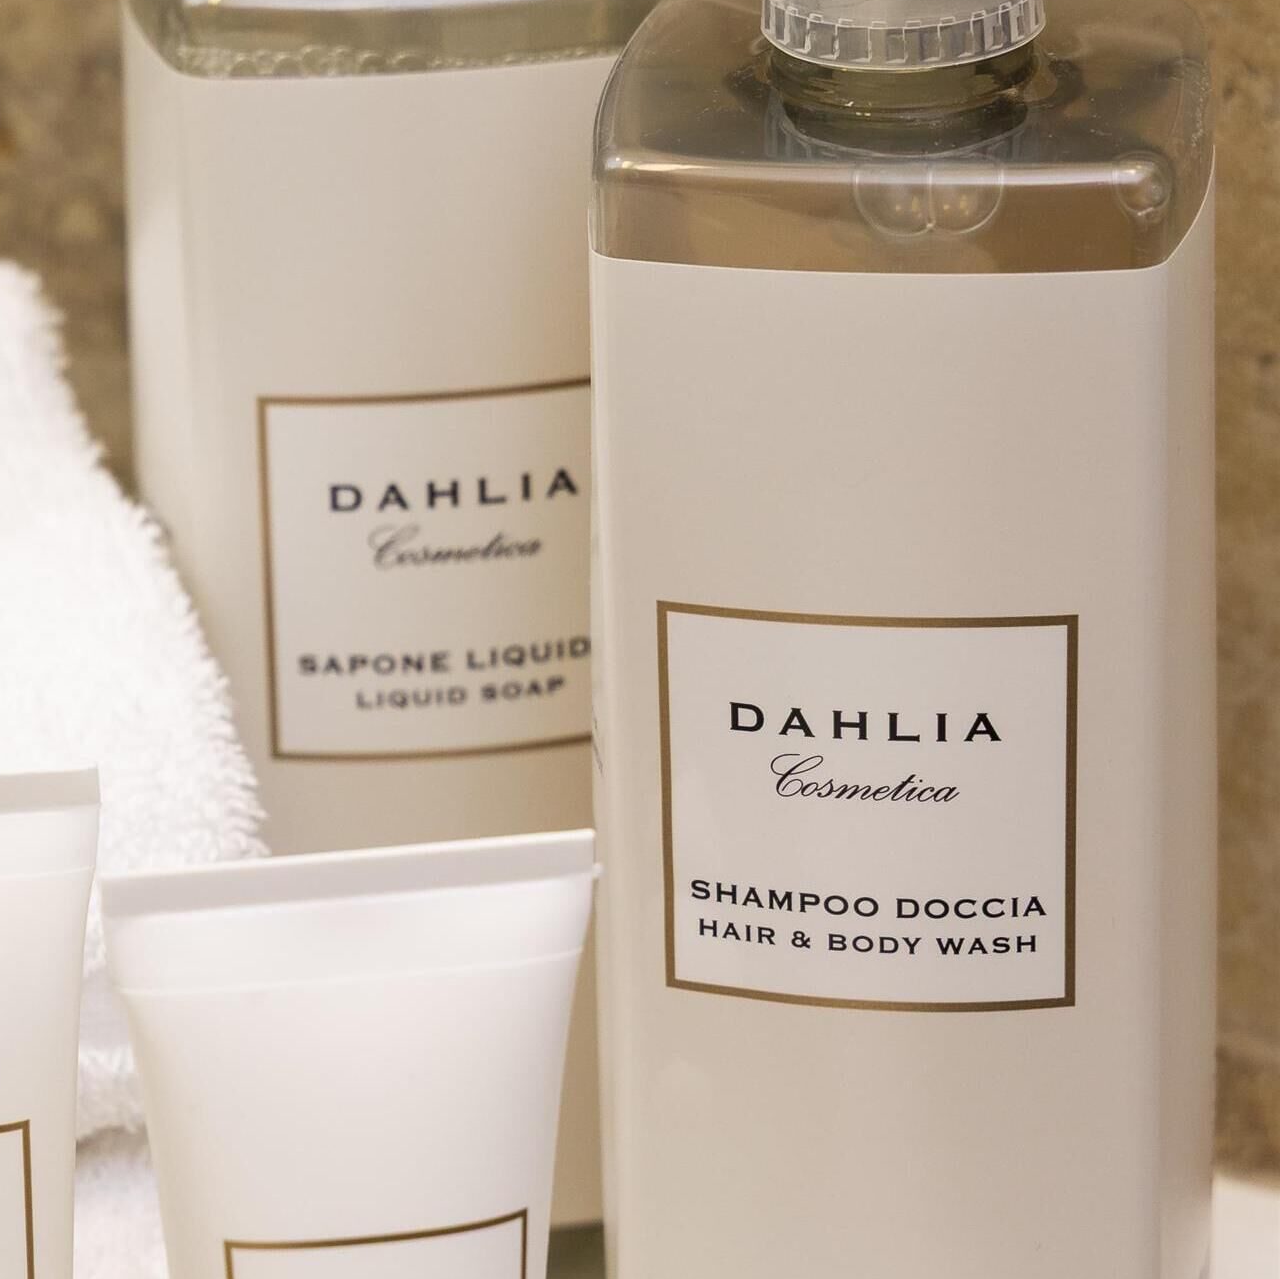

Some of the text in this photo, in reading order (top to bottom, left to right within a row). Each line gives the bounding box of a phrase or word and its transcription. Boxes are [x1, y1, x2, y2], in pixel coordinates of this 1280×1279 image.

[329, 468, 579, 513] DAHLIA
[367, 524, 542, 570] Cosmetica
[298, 651, 450, 675] SAPONE
[356, 676, 566, 710] LIQUID SOAP
[729, 702, 1001, 742] DAHLIA
[770, 753, 959, 803] Cosmetica
[691, 879, 1046, 919] SHAMPOO DOCCIA
[699, 918, 1037, 955] HAIR & BODY WASH
